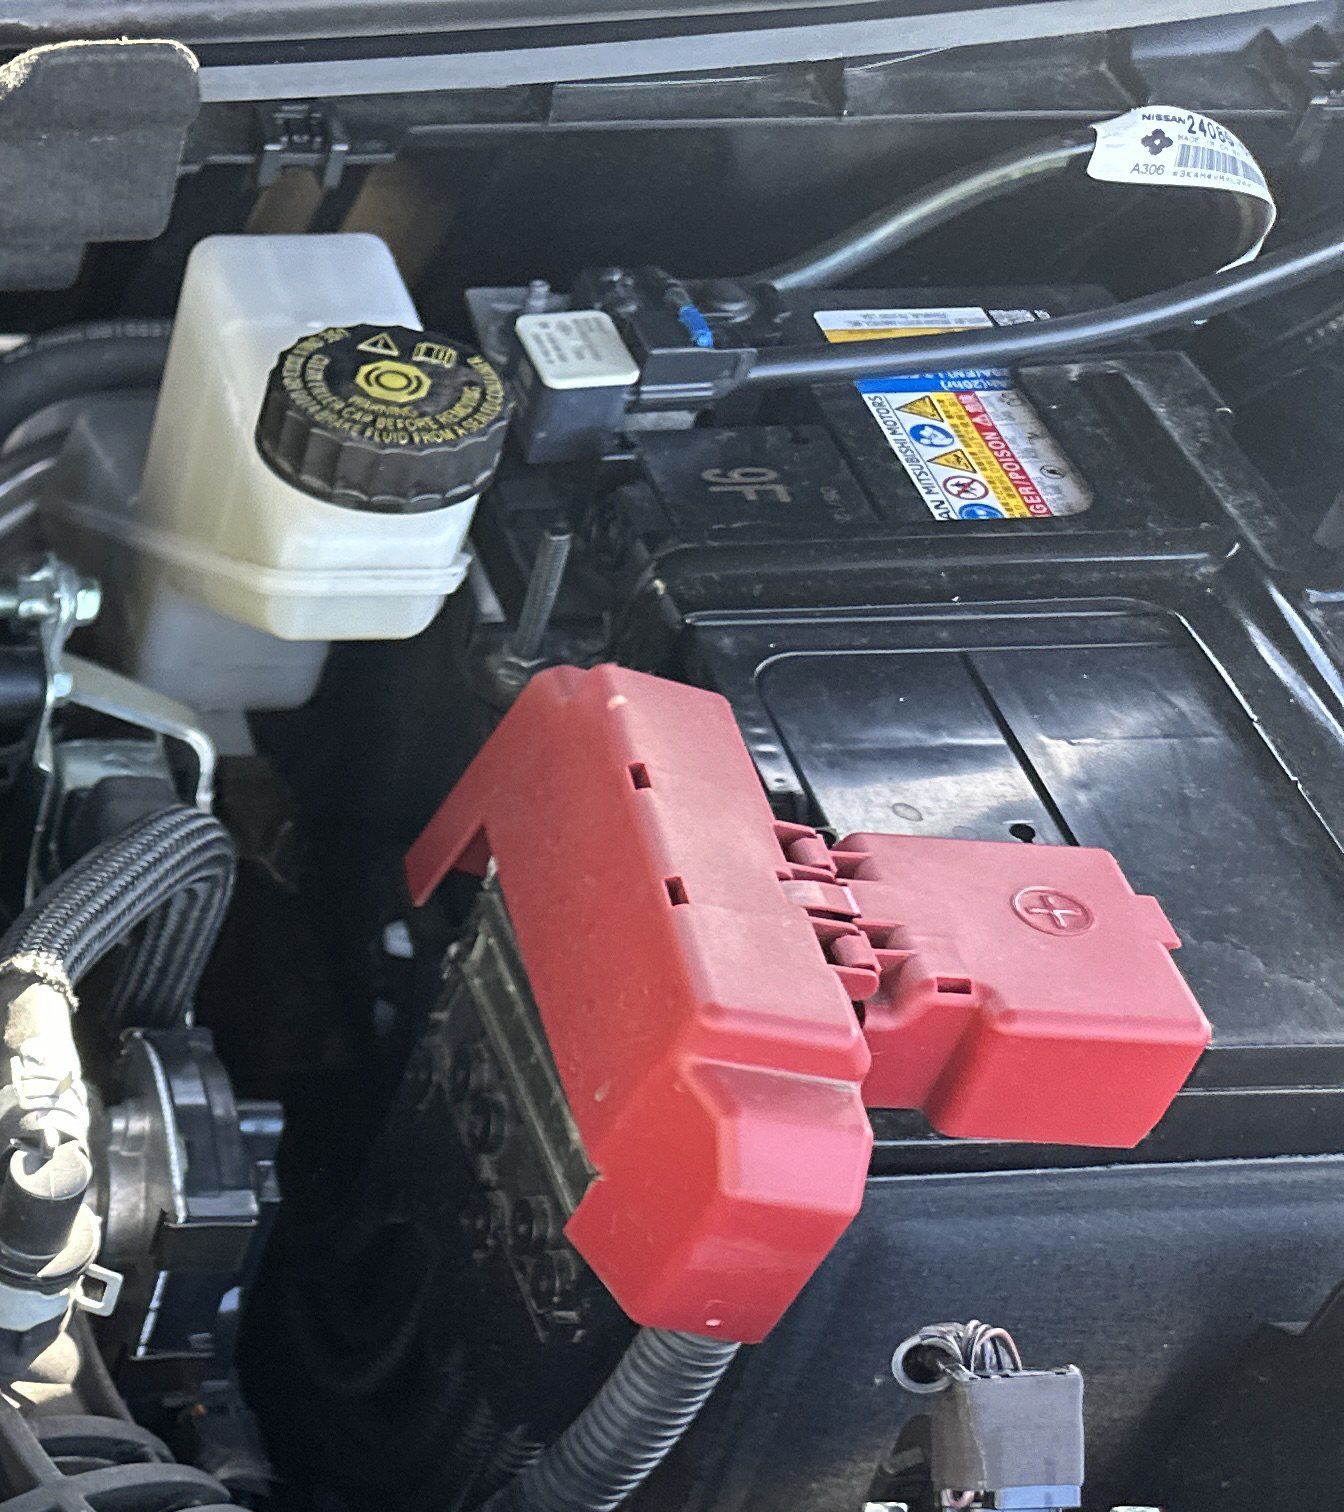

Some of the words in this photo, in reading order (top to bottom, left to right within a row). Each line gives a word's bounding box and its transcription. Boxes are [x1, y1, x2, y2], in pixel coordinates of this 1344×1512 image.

[1141, 113, 1186, 125] NISSAN
[1130, 162, 1166, 176] A306
[375, 416, 439, 431] BEFORE
[867, 395, 900, 436] MOTORS
[364, 426, 409, 445] FLUID
[892, 433, 939, 495] MITSUBISHI
